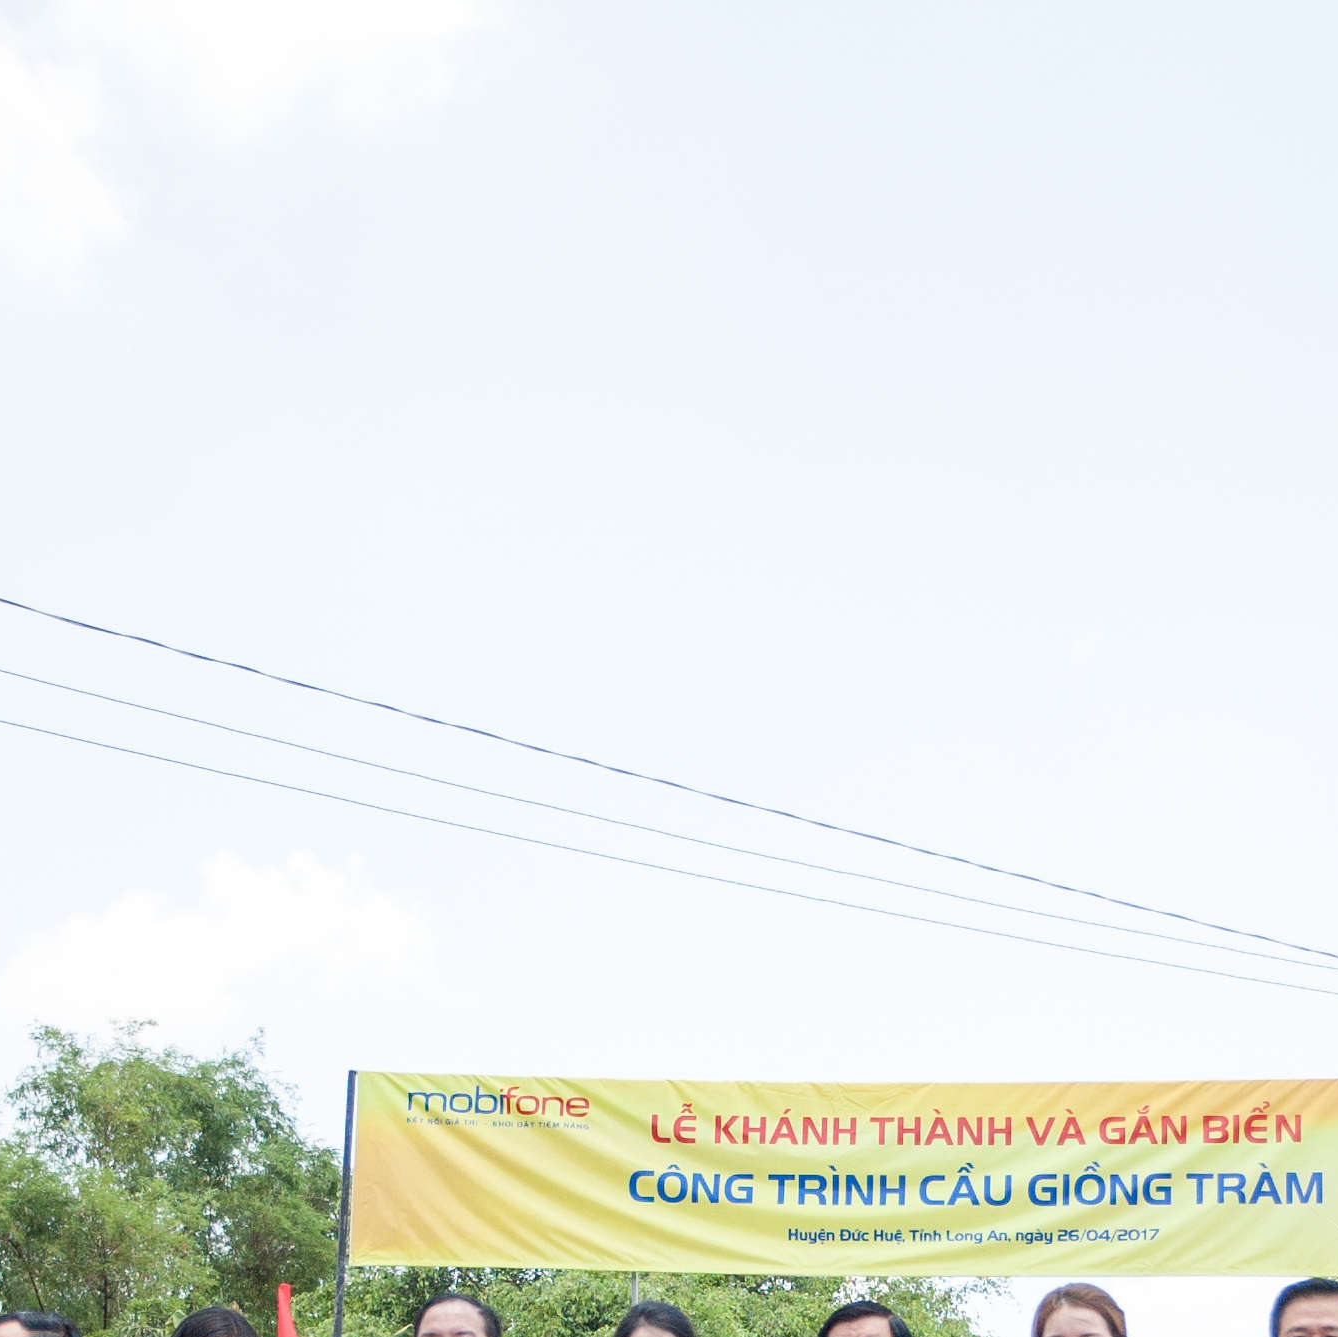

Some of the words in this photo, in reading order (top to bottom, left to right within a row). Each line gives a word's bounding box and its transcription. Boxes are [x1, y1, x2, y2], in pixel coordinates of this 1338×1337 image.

[407, 1085, 590, 1118] mobifone
[650, 1103, 698, 1144] LỄ
[714, 1109, 858, 1146] KHÁNH
[869, 1108, 1013, 1146] THÀNH
[1026, 1108, 1086, 1146] VÀ
[1098, 1105, 1187, 1145] GẮN
[1202, 1101, 1302, 1144] BIỂN
[628, 1164, 755, 1204] CÔNG
[767, 1165, 906, 1206] TRÌNH
[919, 1161, 1013, 1207] CẦU
[1027, 1161, 1173, 1207] GIỒNG
[1186, 1162, 1324, 1205] TRÀM
[787, 1228, 835, 1245] Huyện
[839, 1228, 869, 1242] Đức
[873, 1229, 905, 1244] Huệ,
[909, 1229, 942, 1242] Tỉnh
[946, 1230, 983, 1245] Long
[986, 1230, 1012, 1244] An,
[1015, 1229, 1053, 1245] ngày
[1057, 1228, 1160, 1243] 26/04/2017
